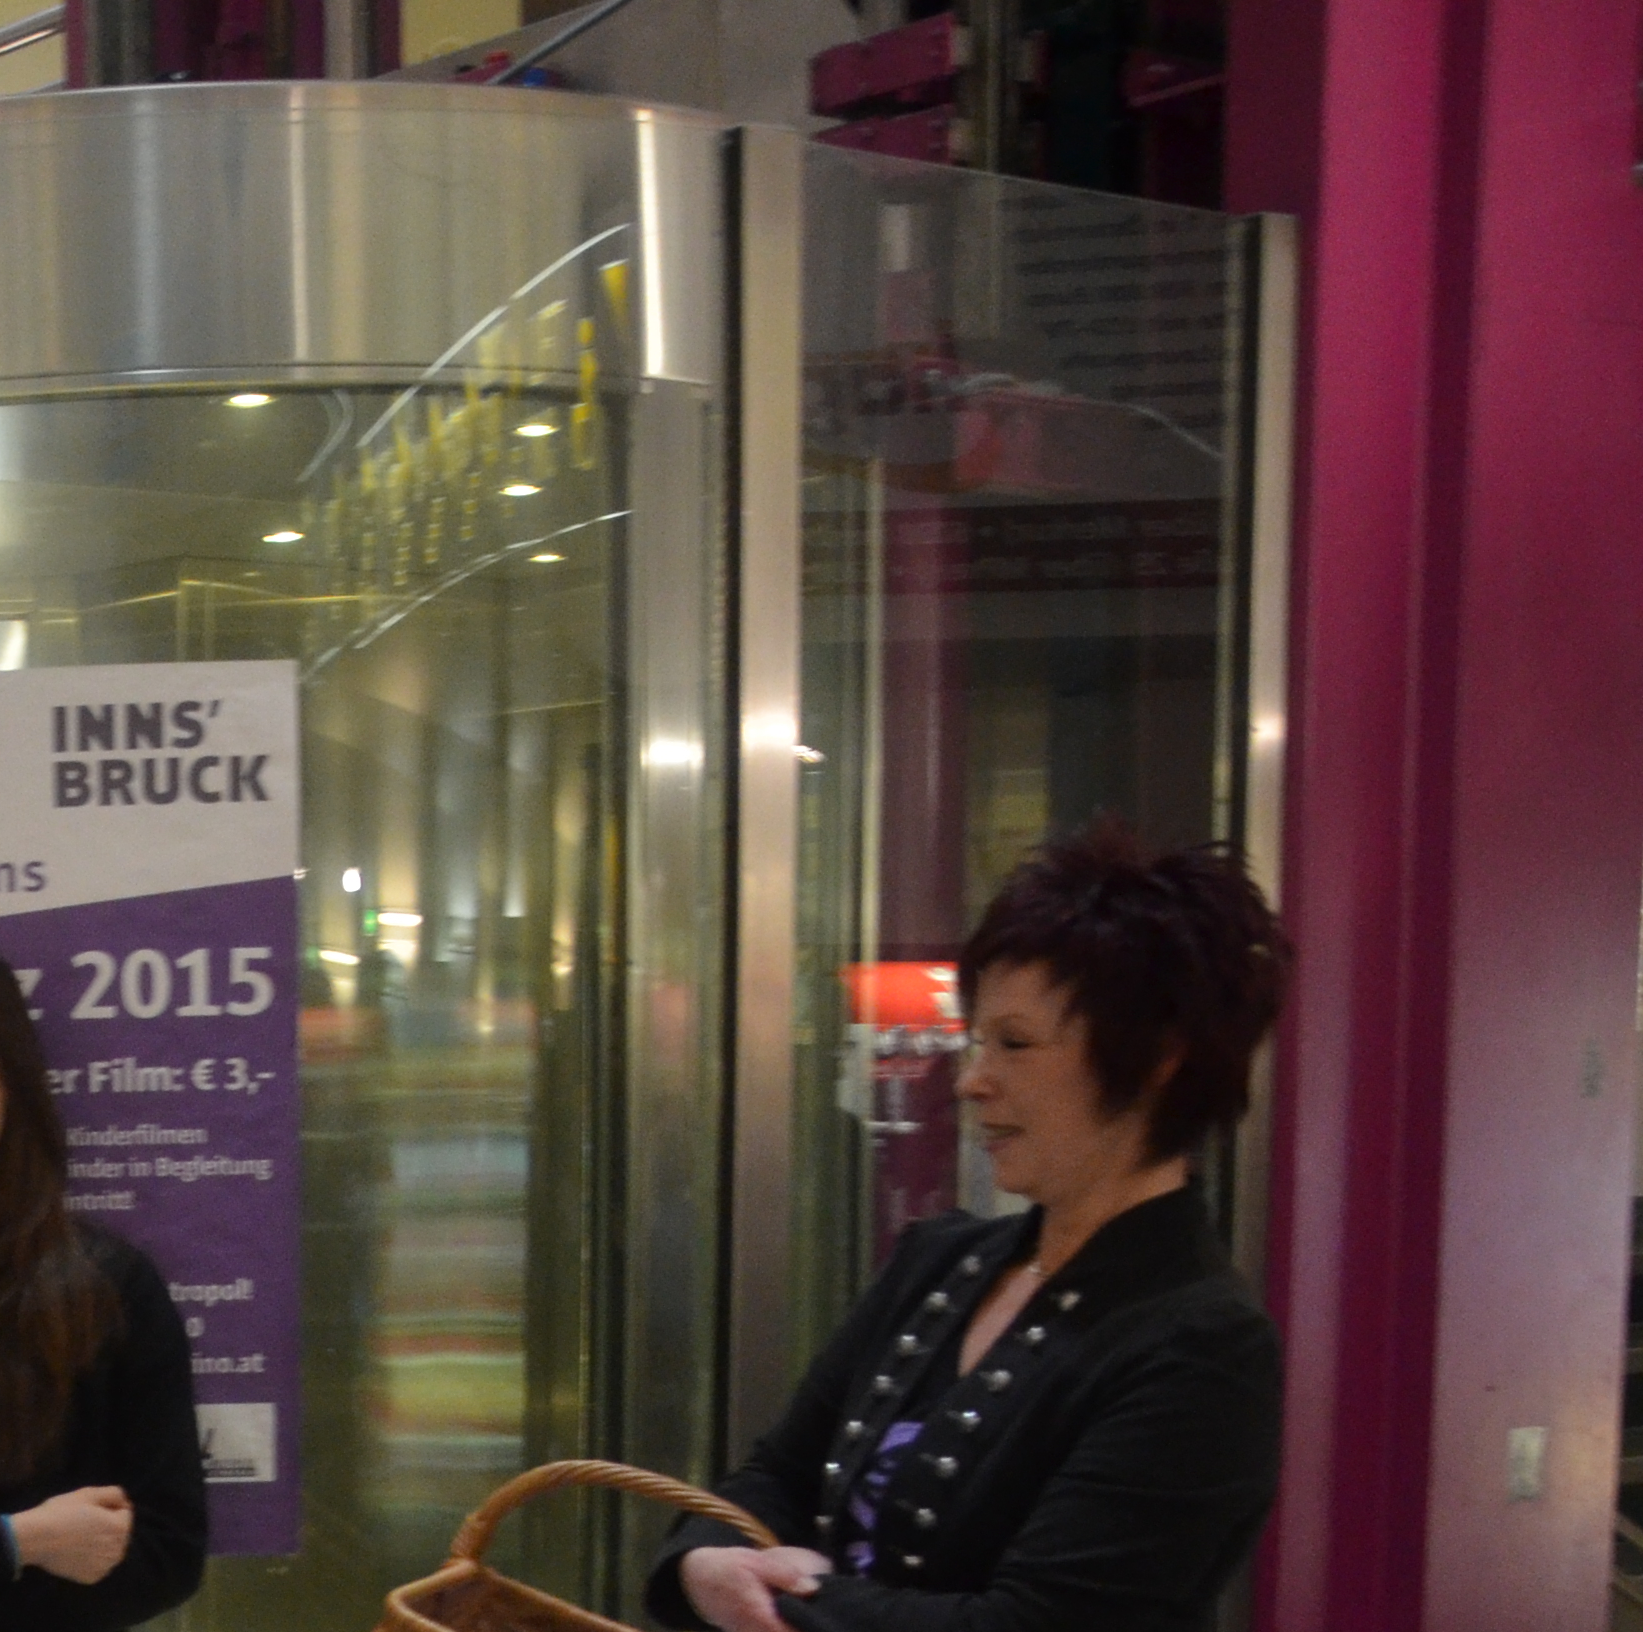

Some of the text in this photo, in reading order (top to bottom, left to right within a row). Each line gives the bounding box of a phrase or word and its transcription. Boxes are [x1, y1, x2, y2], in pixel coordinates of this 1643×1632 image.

[53, 698, 220, 753] INNS'
[54, 754, 270, 809] BRUCK
[68, 945, 276, 1020] 2015
[44, 1066, 81, 1094] er
[87, 1056, 184, 1094] Film:
[190, 1057, 218, 1092] €
[66, 1154, 274, 1182] inder in Begleitung
[190, 1351, 267, 1374] ino.at
